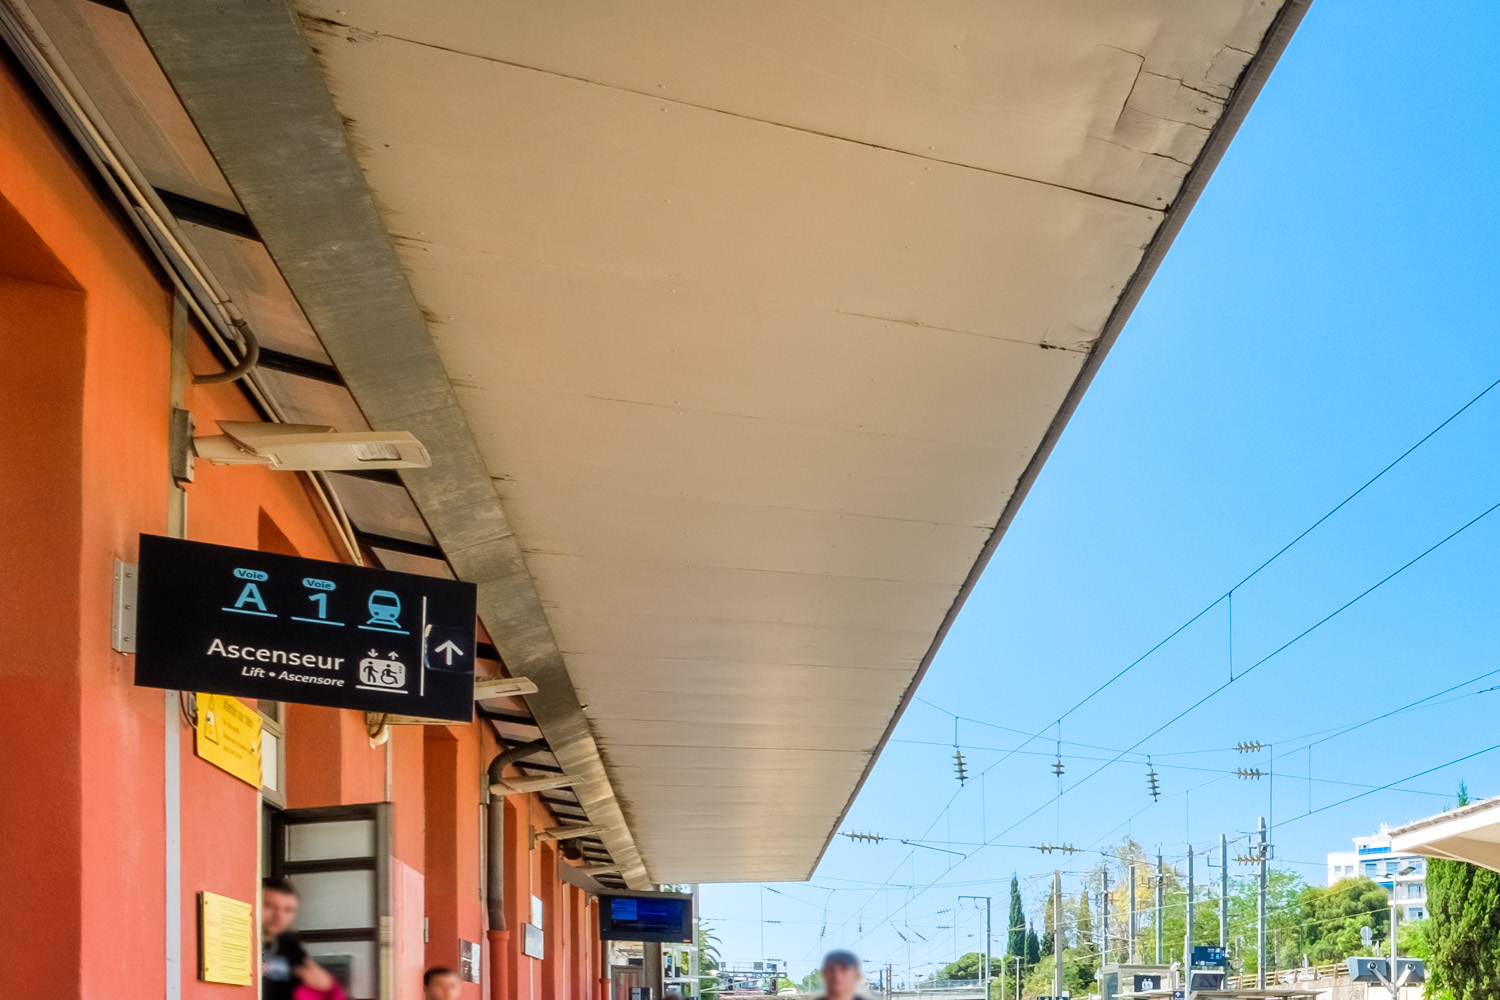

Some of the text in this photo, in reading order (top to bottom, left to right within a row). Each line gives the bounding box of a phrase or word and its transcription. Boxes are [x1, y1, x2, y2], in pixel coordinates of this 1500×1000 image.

[238, 569, 264, 580] Voie
[306, 579, 332, 590] Voie
[234, 582, 268, 612] A
[308, 592, 327, 619] 1
[207, 638, 345, 670] Ascenseur
[241, 666, 345, 687] Lift Ascensore
